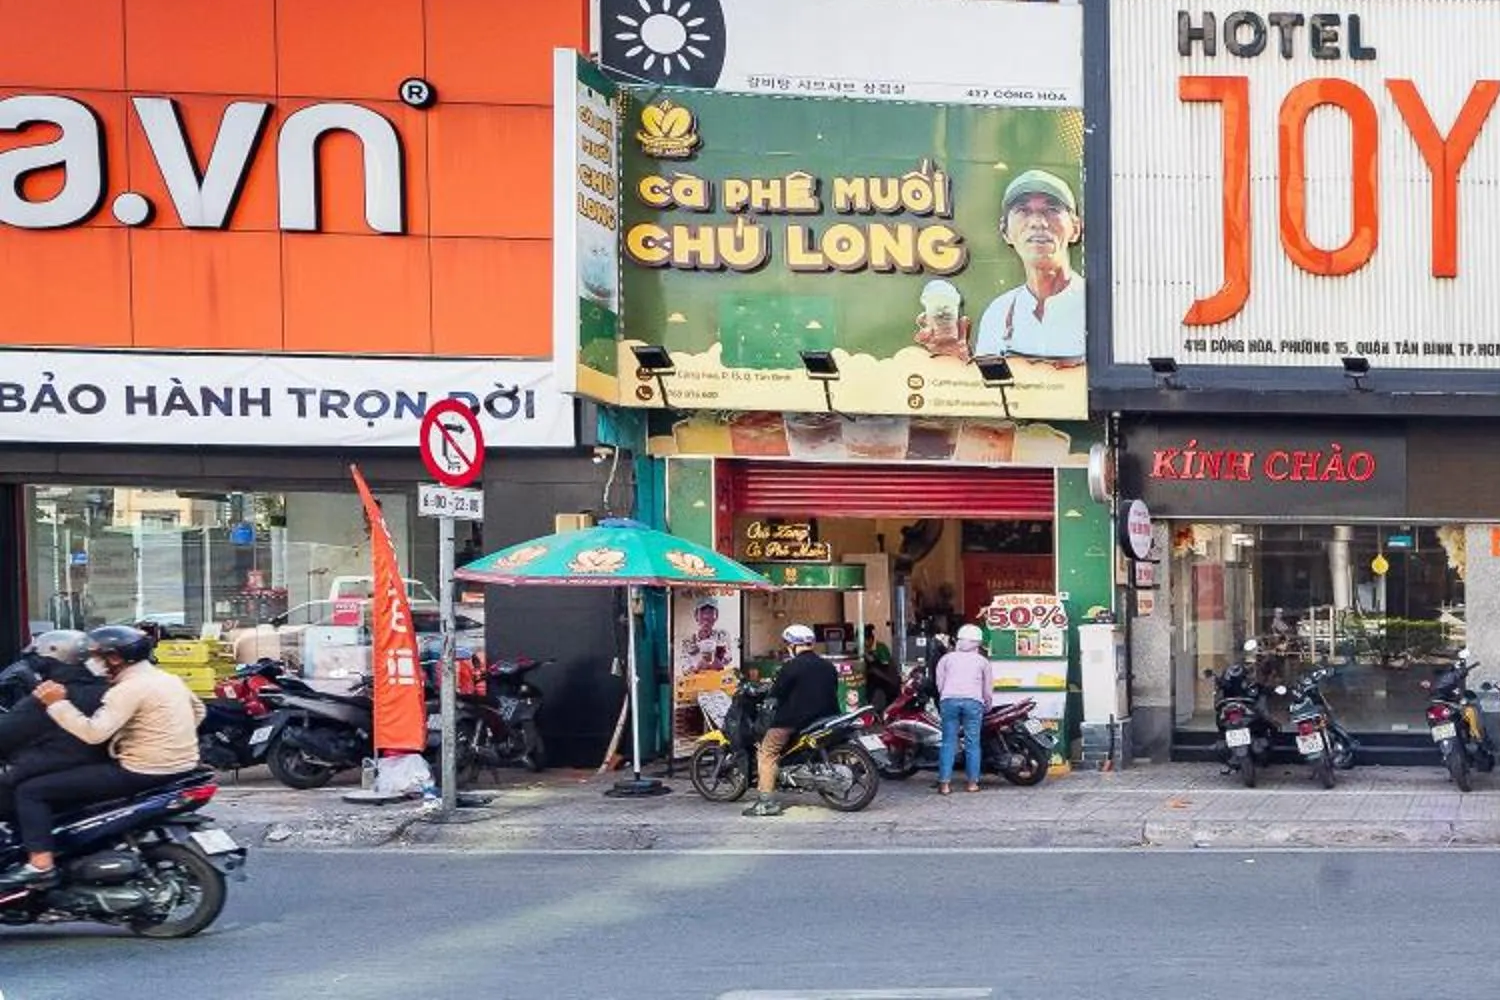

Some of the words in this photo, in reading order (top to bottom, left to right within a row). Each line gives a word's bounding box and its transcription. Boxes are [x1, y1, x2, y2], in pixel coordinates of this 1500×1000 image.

[1177, 10, 1377, 61] HOTEL
[626, 214, 768, 271] CHÚ
[786, 221, 968, 275] LONG
[0, 371, 107, 415] BẢO
[125, 377, 272, 419] HÀNH
[287, 386, 428, 428] TRỌN
[1150, 440, 1255, 482] KÍNH
[1263, 442, 1377, 482] CHÀO
[986, 604, 1068, 629] 50%
